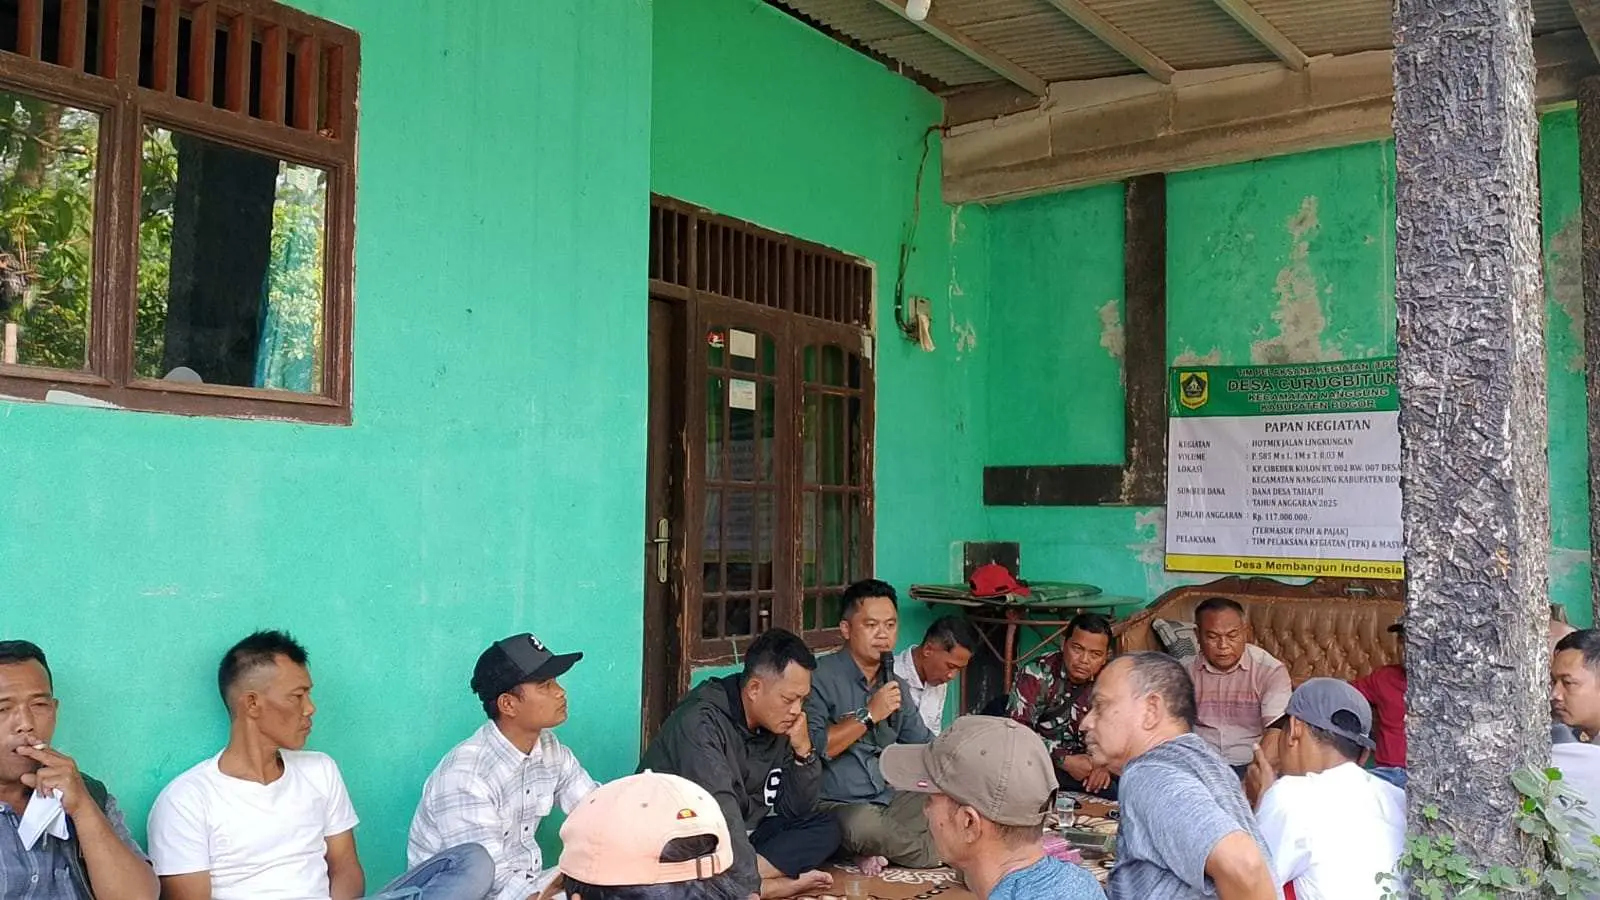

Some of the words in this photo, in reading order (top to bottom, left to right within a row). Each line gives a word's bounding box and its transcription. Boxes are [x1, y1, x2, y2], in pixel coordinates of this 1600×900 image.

[1373, 359, 1397, 370] (TPK
[1228, 378, 1274, 392] DESA
[1277, 372, 1398, 391] CURUGBITUN
[1248, 391, 1318, 402] KECAMATAN
[1319, 387, 1389, 400] NANGGUNG
[1260, 402, 1328, 412] KABUPATEN
[1331, 399, 1375, 409] BOGOR
[1264, 421, 1303, 433] PAPAN
[1307, 419, 1371, 431] KEGIATAN
[1178, 440, 1211, 449] KEGIATAN
[1252, 440, 1281, 448] HOTMIX
[1281, 439, 1304, 448] JALAN
[1305, 437, 1353, 447] LINGKUNGAN
[1178, 453, 1206, 461] VOLUME
[1337, 450, 1344, 459] M
[1178, 464, 1203, 473] LOKASI
[1296, 464, 1321, 473] KULON
[1365, 463, 1380, 472] 007
[1252, 475, 1295, 484] KECAMATAN
[1295, 475, 1337, 484] NANGGUNG
[1338, 475, 1384, 484] KABUPATEN
[1207, 487, 1226, 496] DANA
[1252, 487, 1272, 496] DANA
[1272, 487, 1291, 496] DESA
[1293, 487, 1317, 496] TAHAP
[1252, 499, 1276, 507] TAHUN
[1277, 499, 1317, 508] ANGGARAN
[1318, 499, 1338, 508] 2025
[1176, 511, 1203, 520] JUMLAH
[1206, 511, 1243, 520] ANGGARAN
[1294, 527, 1314, 535] UPAH
[1176, 535, 1216, 544] PELAKSANA
[1252, 537, 1266, 546] TIM
[1267, 538, 1308, 546] PELAKSANA
[1309, 538, 1346, 548] KEGIATAN
[1371, 540, 1377, 548] &
[1379, 540, 1401, 549] MASY
[1234, 559, 1262, 570] Desa
[1265, 561, 1337, 573] Membangun
[1341, 564, 1402, 575] Indonesia
